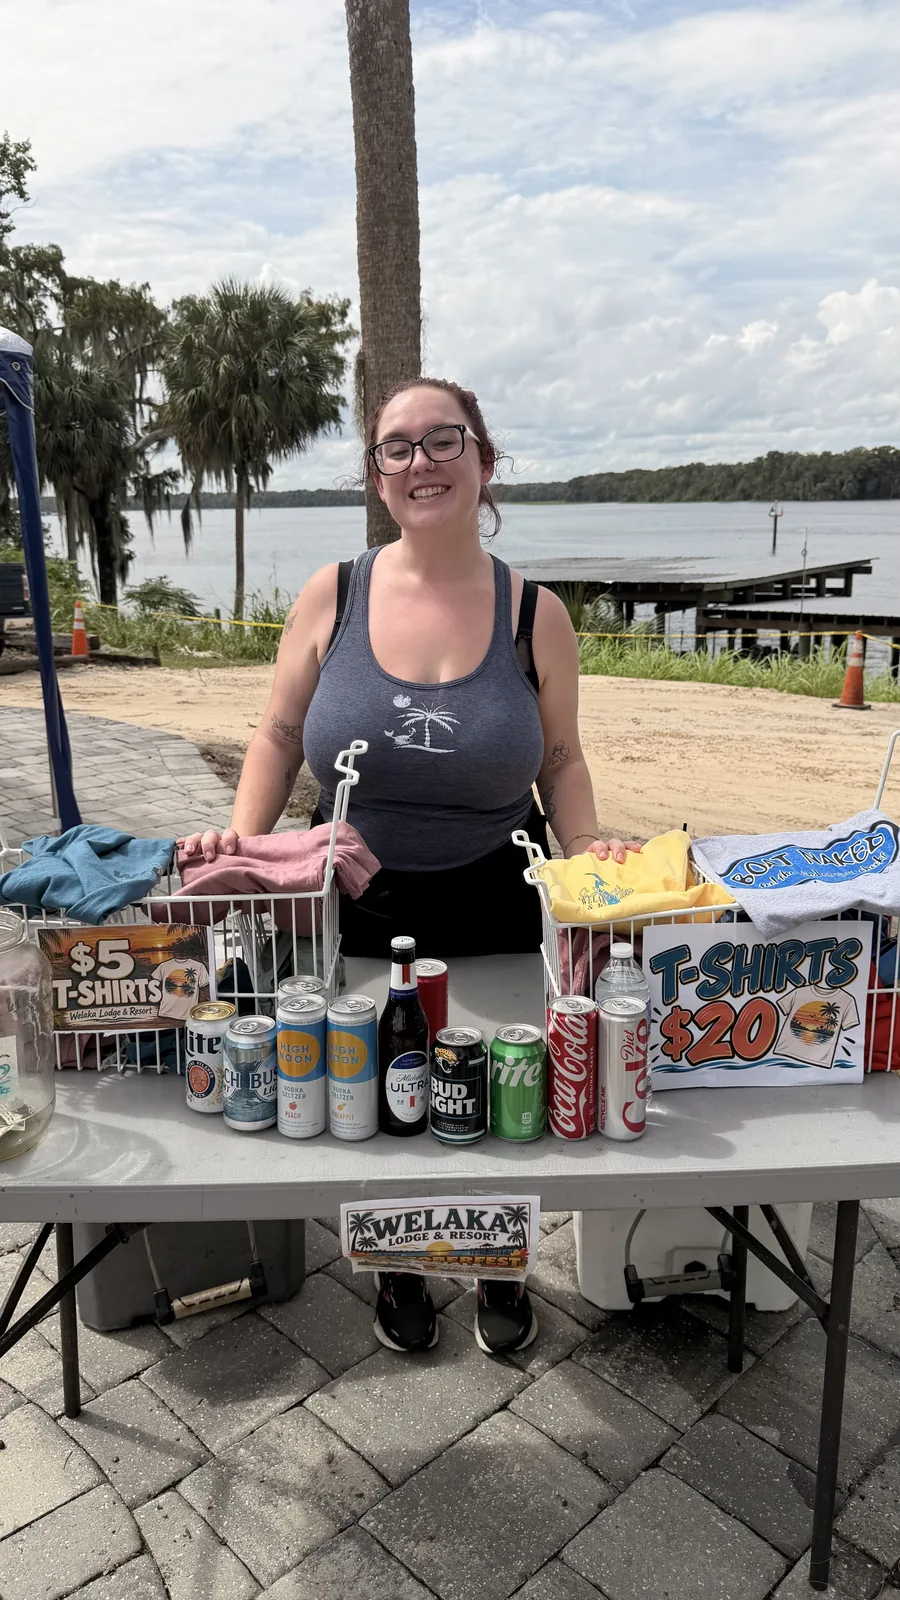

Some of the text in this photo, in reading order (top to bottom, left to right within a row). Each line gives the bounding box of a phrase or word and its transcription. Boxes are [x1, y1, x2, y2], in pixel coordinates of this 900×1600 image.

[731, 833, 885, 885] BOAT NAKED
[69, 938, 135, 980] $5
[650, 937, 863, 1006] T-SHIRTS
[53, 978, 163, 1009] T-SHIRTS
[69, 1006, 152, 1021] Welaka Lodge & Resort
[660, 996, 780, 1066] $20
[280, 1042, 309, 1053] HIGH
[328, 1044, 356, 1054] HIGH
[621, 1029, 635, 1061] Diet
[279, 1052, 312, 1063] NOON
[249, 1067, 278, 1090] BUS
[491, 1055, 542, 1087] rite
[263, 1086, 278, 1096] LIG
[283, 1085, 304, 1093] VODKA
[332, 1085, 352, 1094] VODKA
[390, 1077, 429, 1093] ULTRA
[431, 1075, 468, 1099] BUD
[282, 1091, 307, 1099] SELTZER
[331, 1091, 354, 1100] SELTZER
[431, 1092, 476, 1115] IGHT
[285, 1111, 301, 1119] PEACH
[370, 1208, 510, 1240] WELAKA
[388, 1231, 499, 1247] LODGE & RESORT
